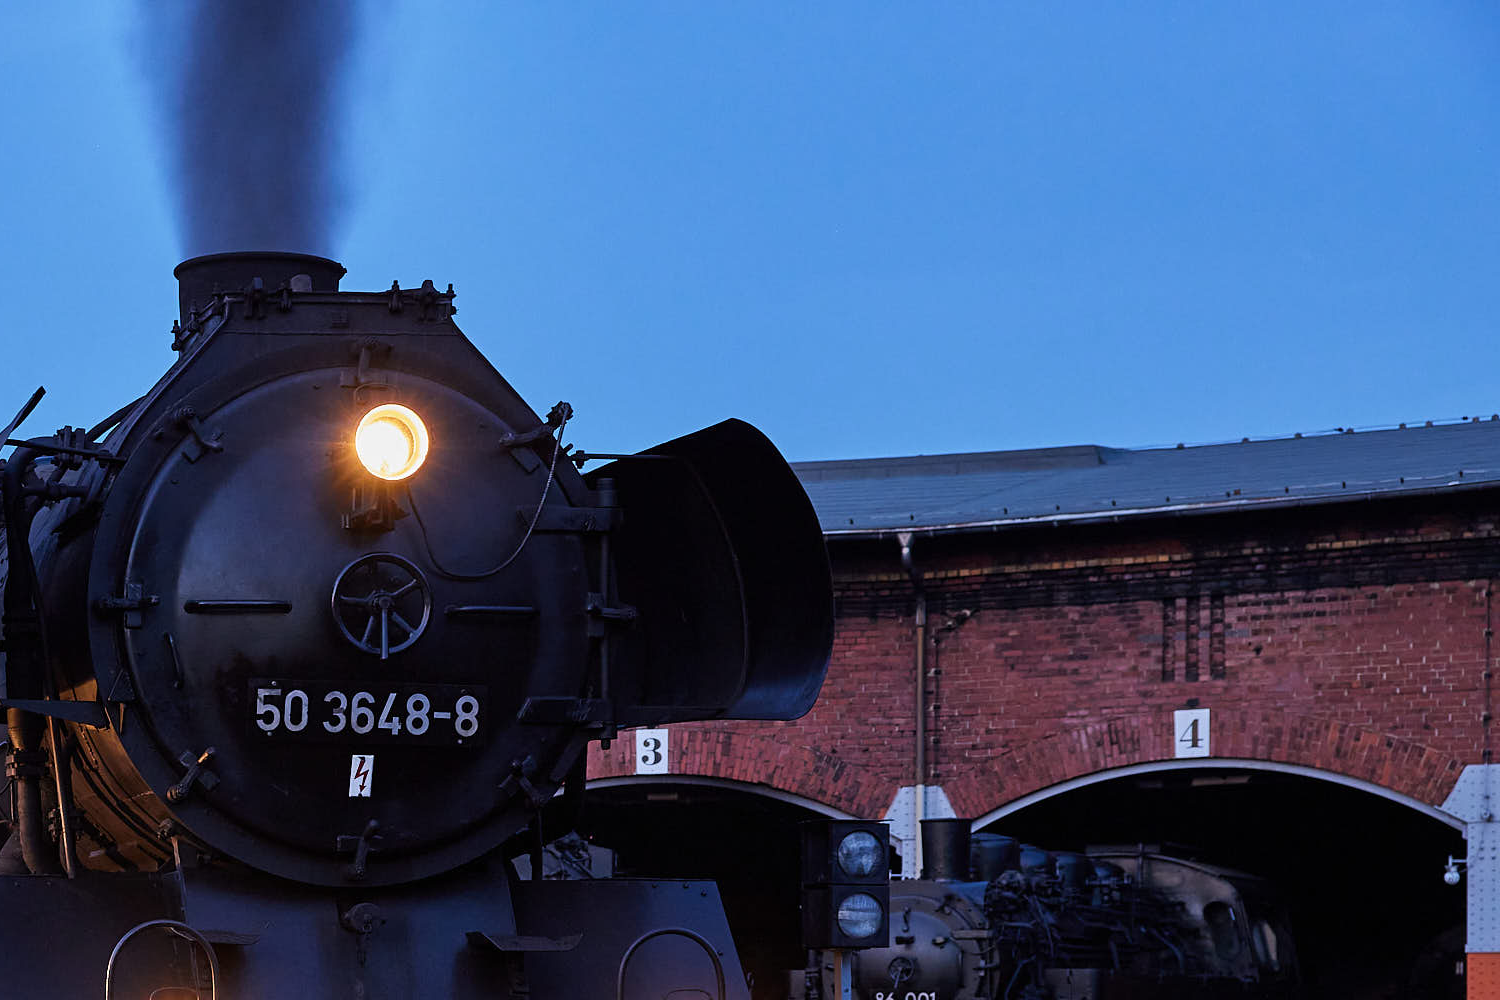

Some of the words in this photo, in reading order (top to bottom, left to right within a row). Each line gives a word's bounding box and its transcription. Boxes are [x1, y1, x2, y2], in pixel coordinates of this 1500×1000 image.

[256, 688, 309, 731] 50
[322, 690, 479, 737] 3648-8
[1180, 718, 1204, 749] 4
[641, 737, 662, 766] 3
